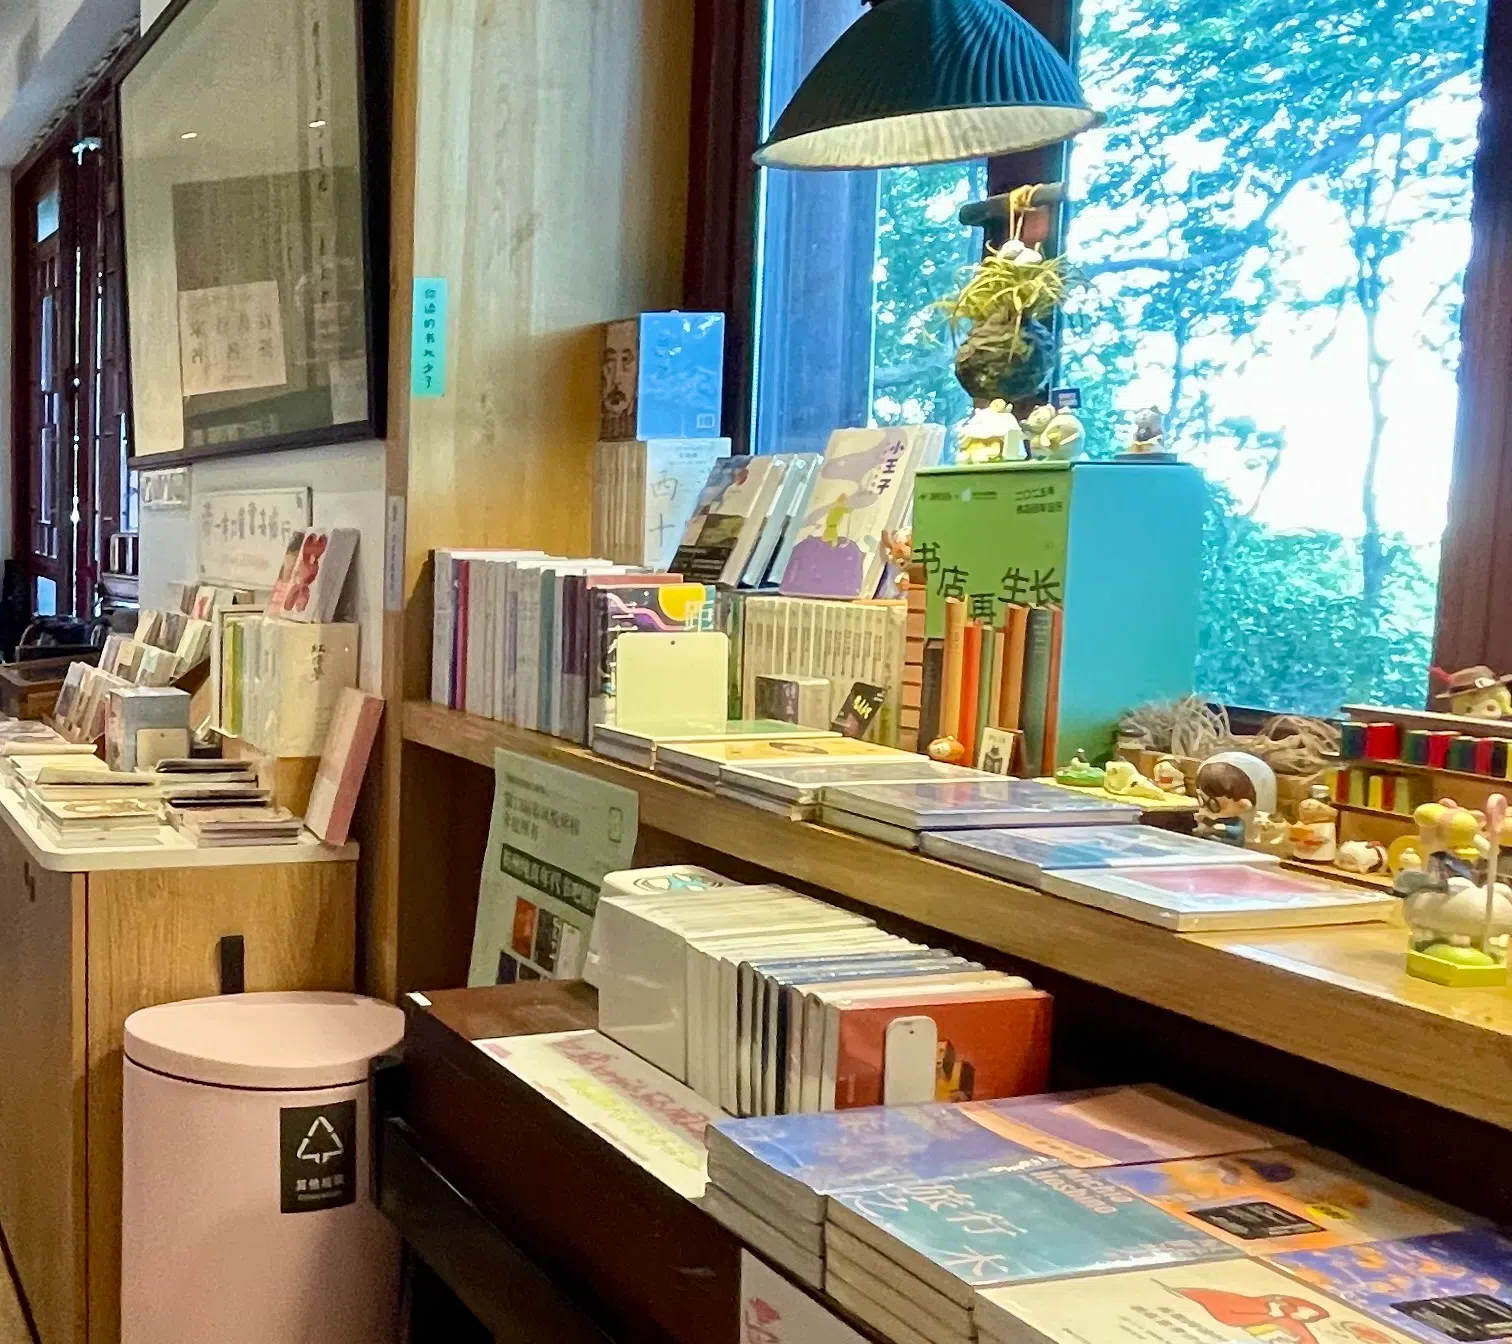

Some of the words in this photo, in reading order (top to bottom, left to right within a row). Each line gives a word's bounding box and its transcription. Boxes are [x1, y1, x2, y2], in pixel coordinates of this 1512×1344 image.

[877, 440, 905, 495] 小王子
[912, 541, 1063, 625] 书店再生长
